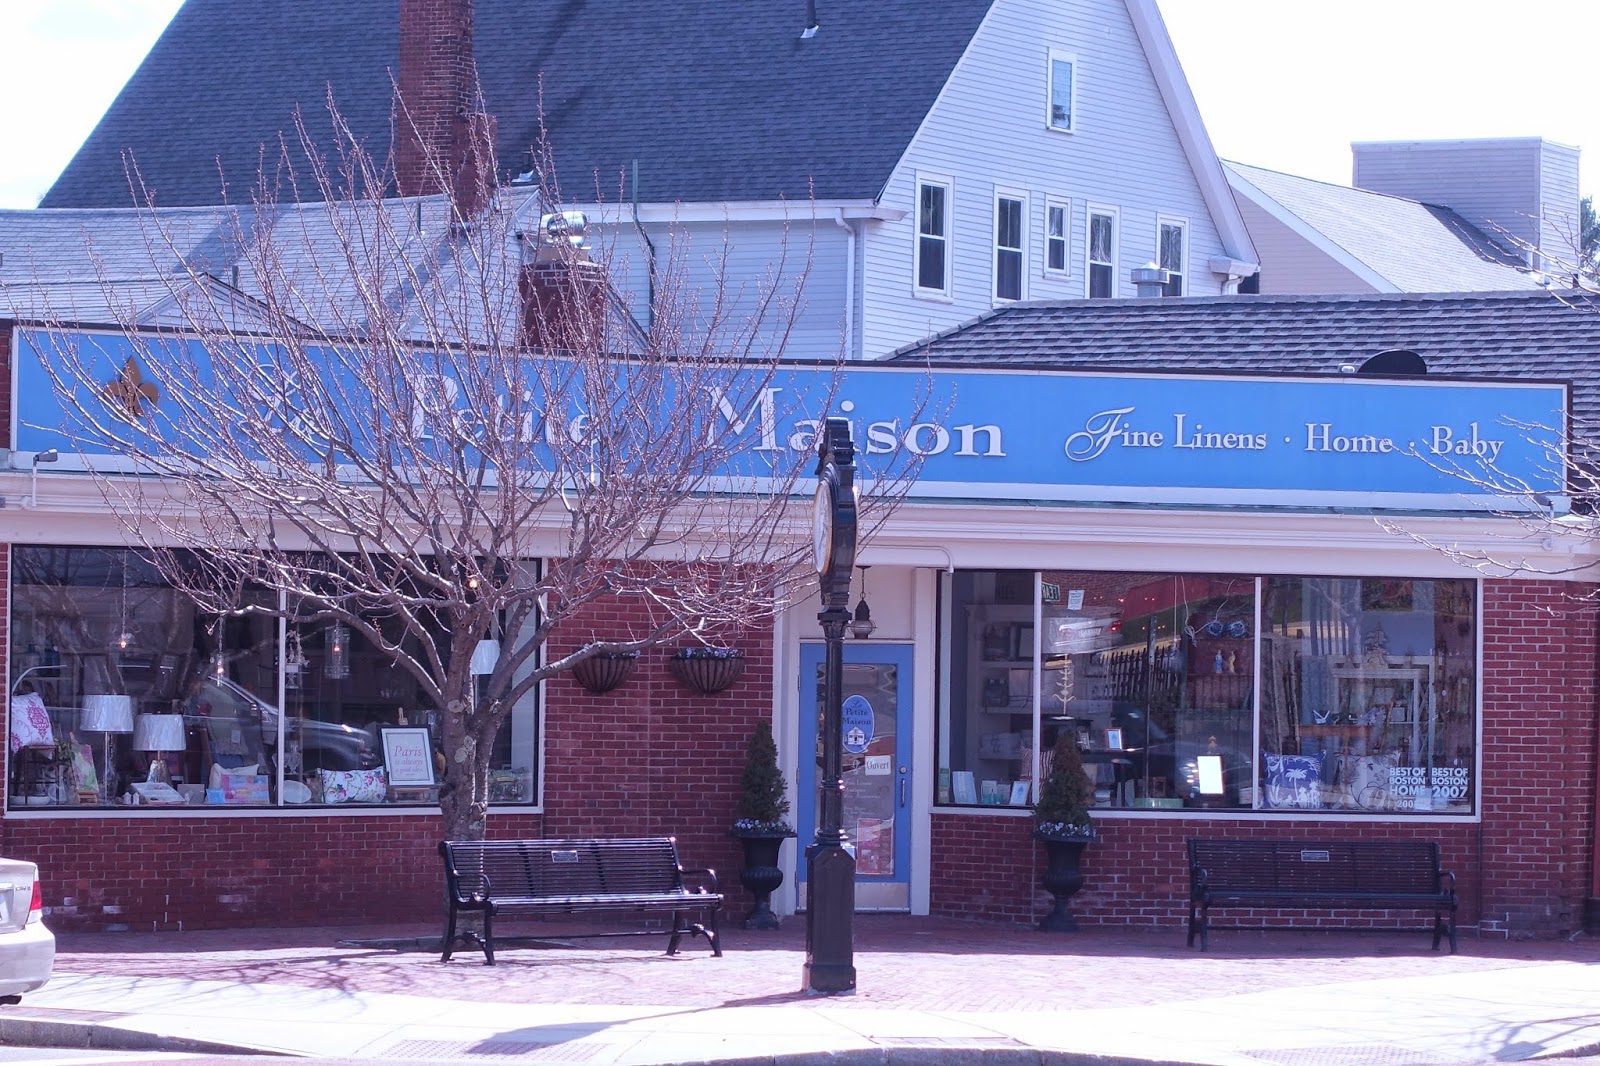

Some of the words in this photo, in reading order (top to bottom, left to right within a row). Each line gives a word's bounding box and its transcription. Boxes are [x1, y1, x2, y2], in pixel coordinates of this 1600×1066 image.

[1065, 406, 1164, 462] Fine
[1173, 413, 1267, 450] Linens
[1305, 422, 1393, 453] Home
[1430, 422, 1504, 463] Baby
[846, 707, 869, 716] Petite
[842, 717, 872, 725] Maison
[394, 745, 422, 757] Paris
[866, 759, 890, 770] Ouvert
[1389, 777, 1426, 785] BOSTON
[1431, 777, 1468, 785] BOSTON
[1389, 785, 1426, 796] HOME
[1432, 786, 1468, 798] 2007
[1396, 800, 1415, 808] 200
